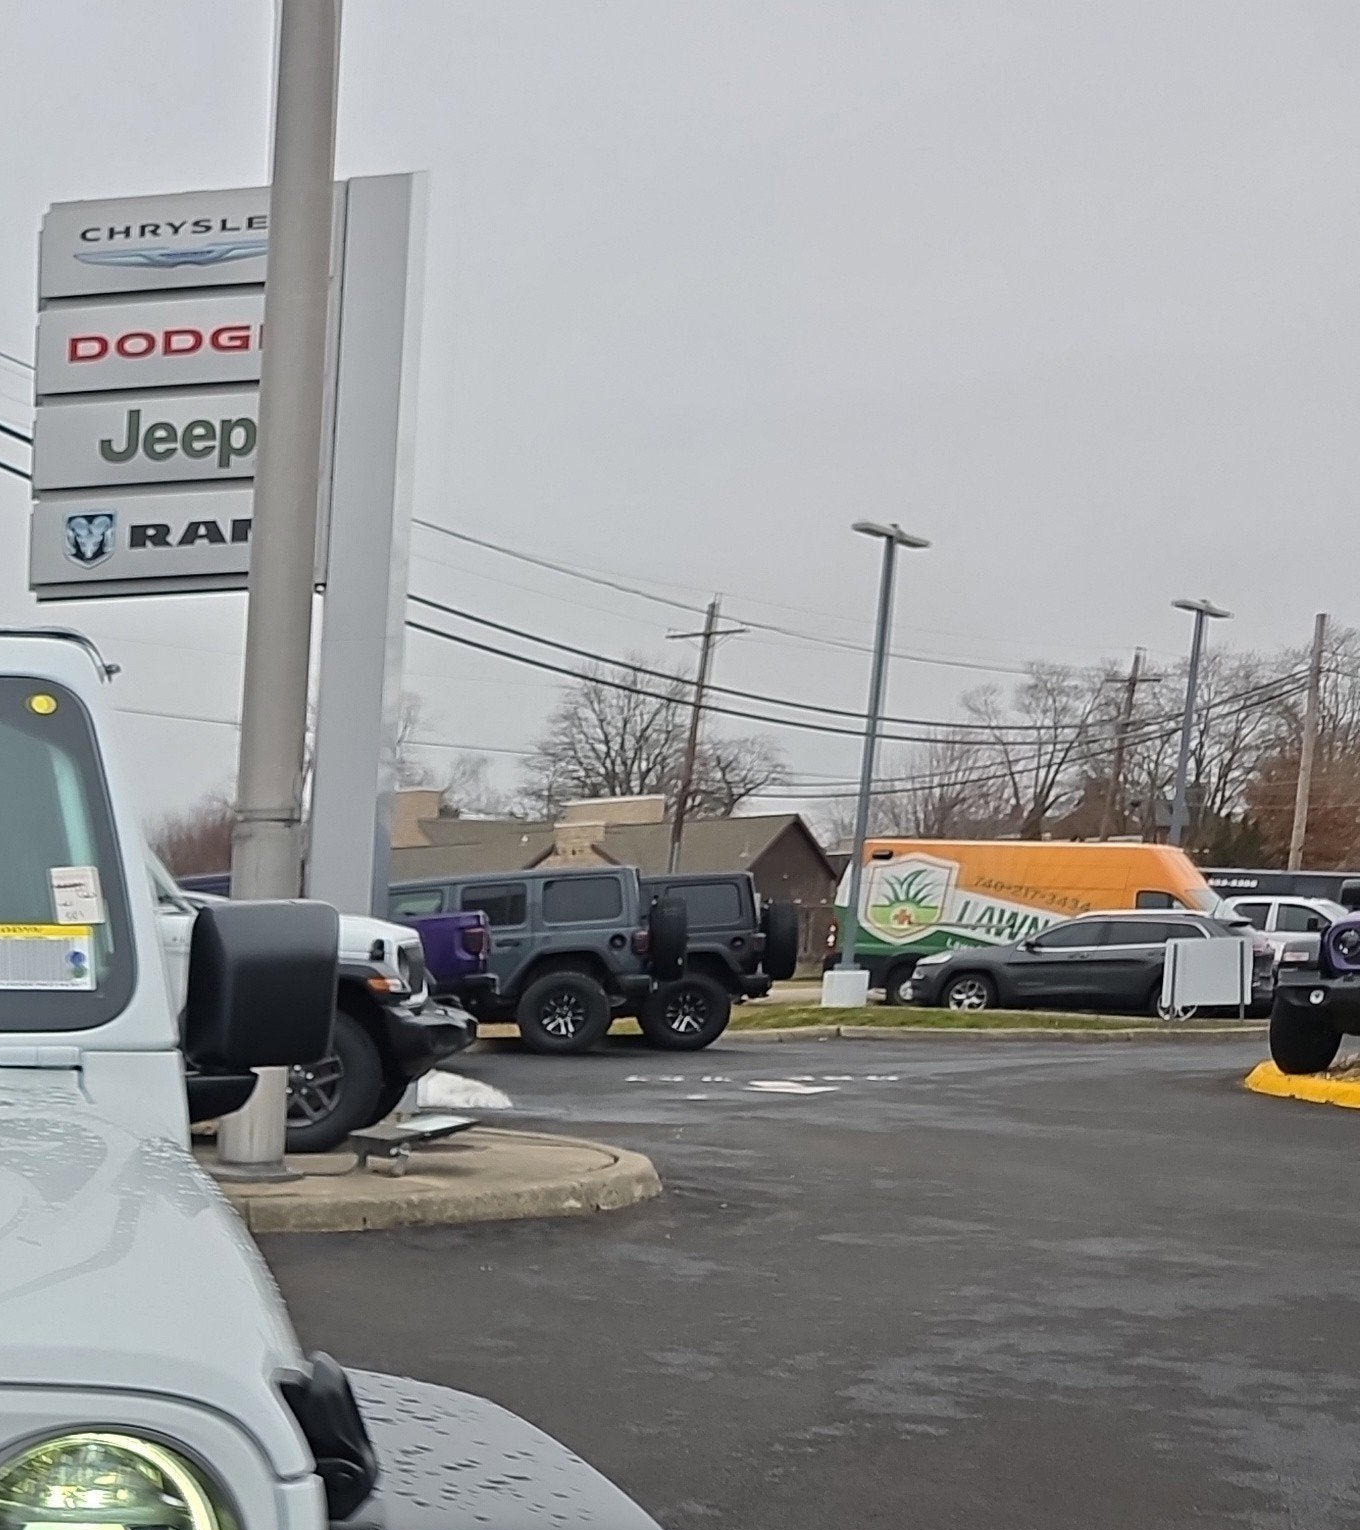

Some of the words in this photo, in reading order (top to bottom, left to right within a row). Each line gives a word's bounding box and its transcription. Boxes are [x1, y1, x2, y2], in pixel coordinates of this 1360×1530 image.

[80, 215, 267, 241] CHRYSLE
[68, 325, 264, 362] DODG
[99, 409, 257, 468] Jeep
[956, 899, 1051, 941] LAWN
